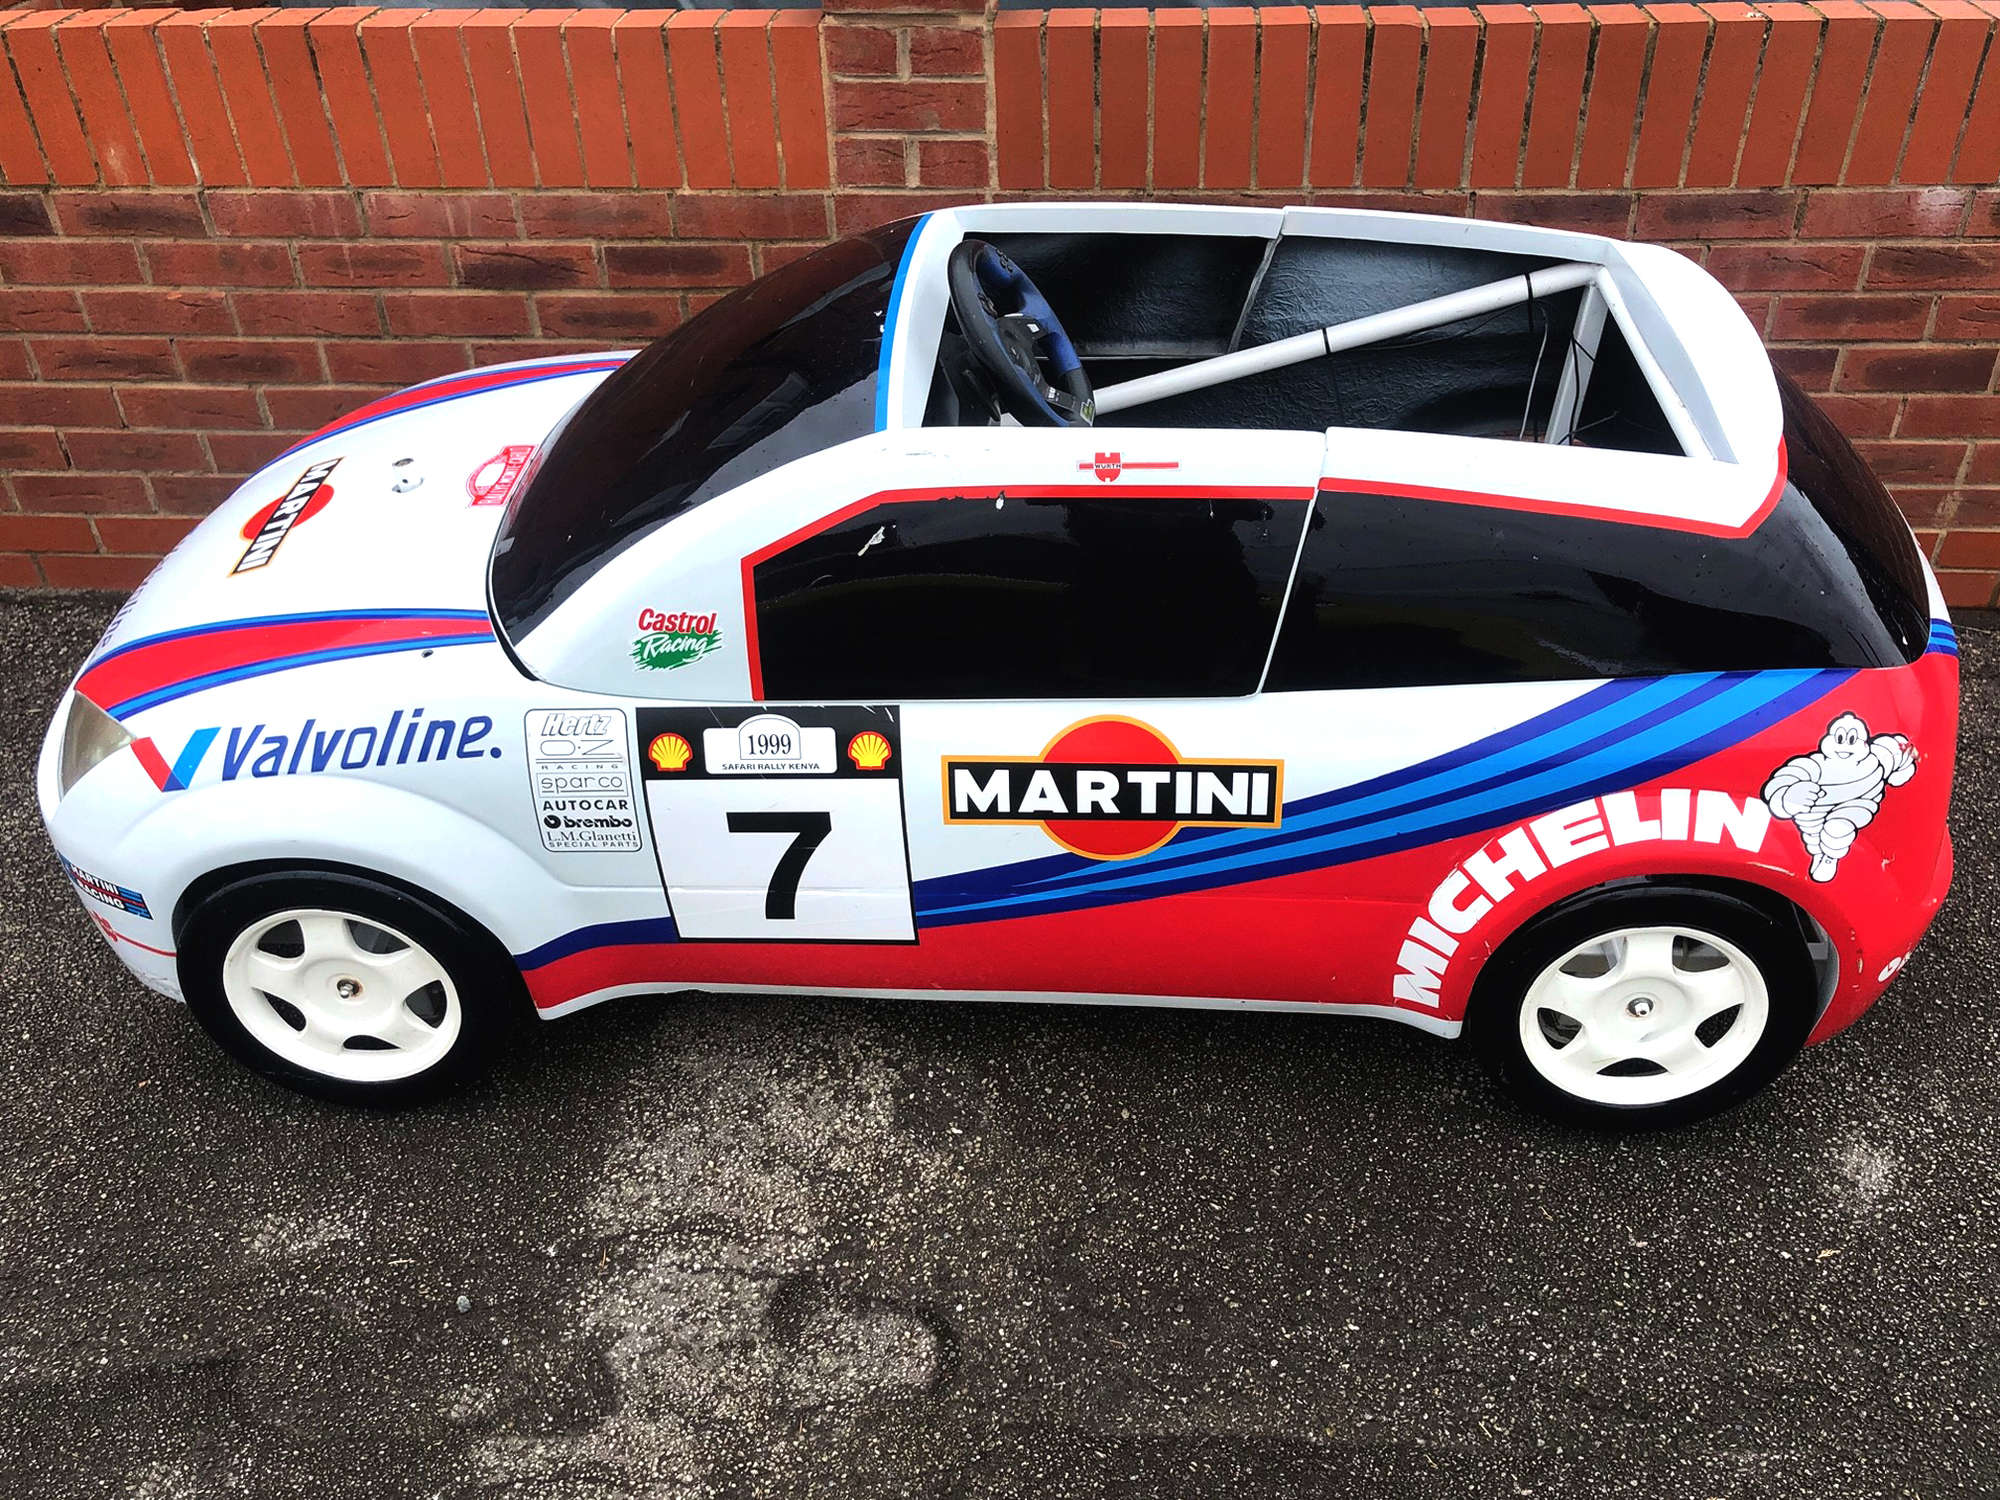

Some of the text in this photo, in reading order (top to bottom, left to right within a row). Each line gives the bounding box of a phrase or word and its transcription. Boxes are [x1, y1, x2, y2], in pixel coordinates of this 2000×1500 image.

[235, 458, 339, 572] MARTINI
[638, 608, 717, 634] Castrol
[641, 634, 709, 662] Racing
[541, 713, 612, 737] Hertz
[747, 733, 791, 755] 1999
[541, 776, 623, 794] sparco
[953, 768, 1270, 816] MARTINI
[543, 800, 629, 811] AUTOCAR
[563, 815, 633, 828] brembo
[726, 812, 832, 919] 7
[71, 864, 120, 895] MARTINI
[1393, 788, 1772, 1010] MICHELIN
